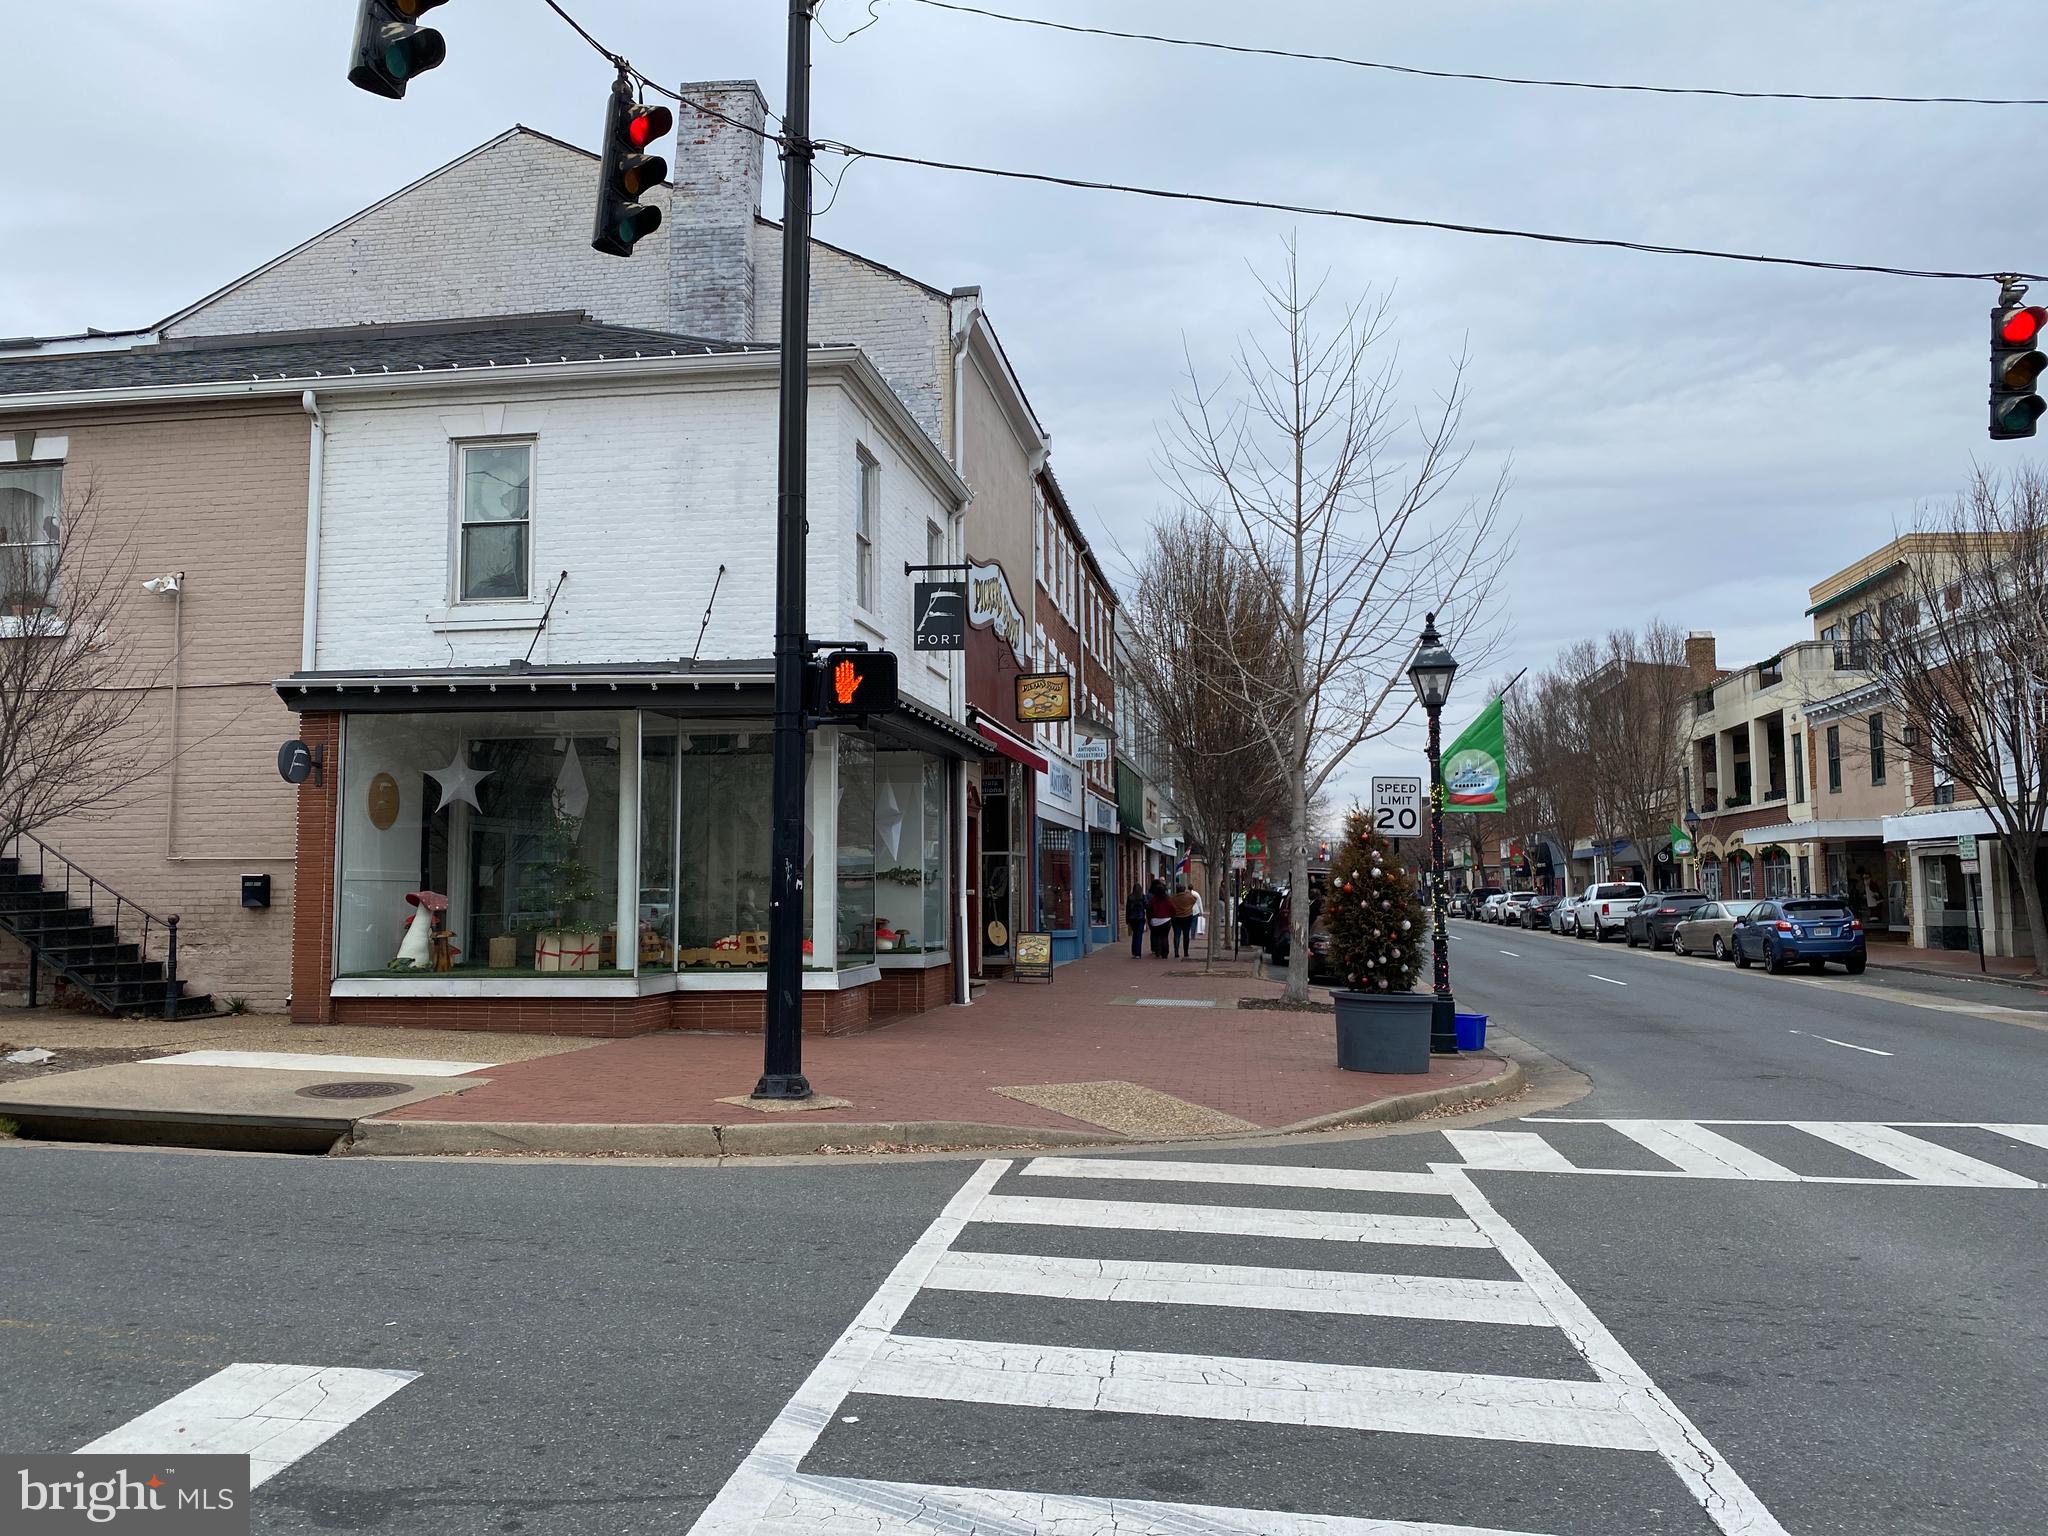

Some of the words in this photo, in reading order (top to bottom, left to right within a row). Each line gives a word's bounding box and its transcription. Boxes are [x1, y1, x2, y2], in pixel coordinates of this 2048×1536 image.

[917, 634, 961, 645] FORT
[1376, 783, 1417, 794] SPEED
[1380, 795, 1413, 805] LIMIT
[1376, 807, 1417, 830] 20
